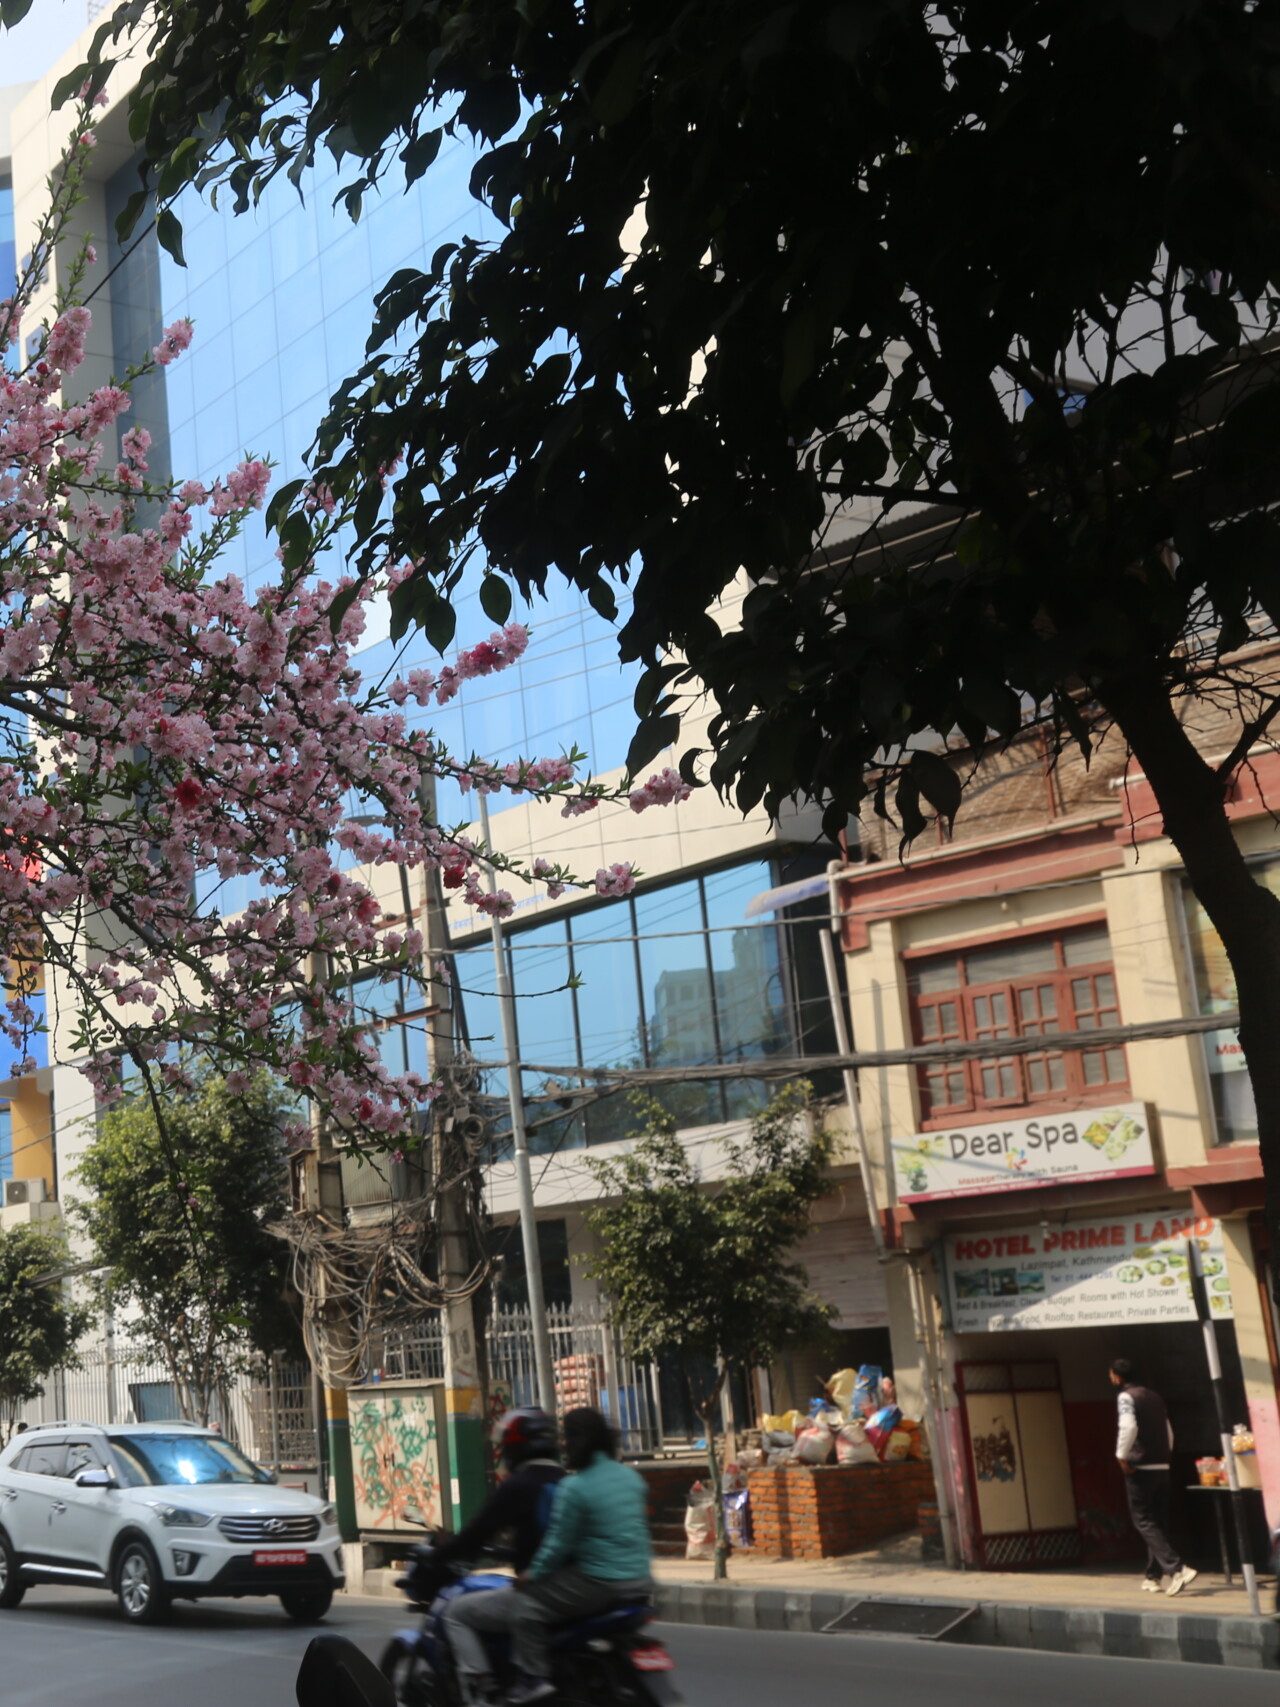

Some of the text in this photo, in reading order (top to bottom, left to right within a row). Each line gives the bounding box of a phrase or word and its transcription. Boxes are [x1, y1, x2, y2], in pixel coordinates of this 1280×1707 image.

[949, 1122, 1078, 1159] Dear Spa
[1050, 1164, 1078, 1174] Sauna
[955, 1217, 1214, 1260] HOTEL PRIME LAND
[1072, 1254, 1133, 1267] Kathmandu
[1047, 1294, 1075, 1306] Budget
[1080, 1292, 1107, 1302] Rooms
[1110, 1290, 1127, 1300] with
[1129, 1288, 1145, 1299] Hot
[1147, 1286, 1180, 1298] Shower
[1044, 1311, 1076, 1323] Rooftop
[1127, 1306, 1157, 1317] Private
[1159, 1305, 1191, 1316] Parties
